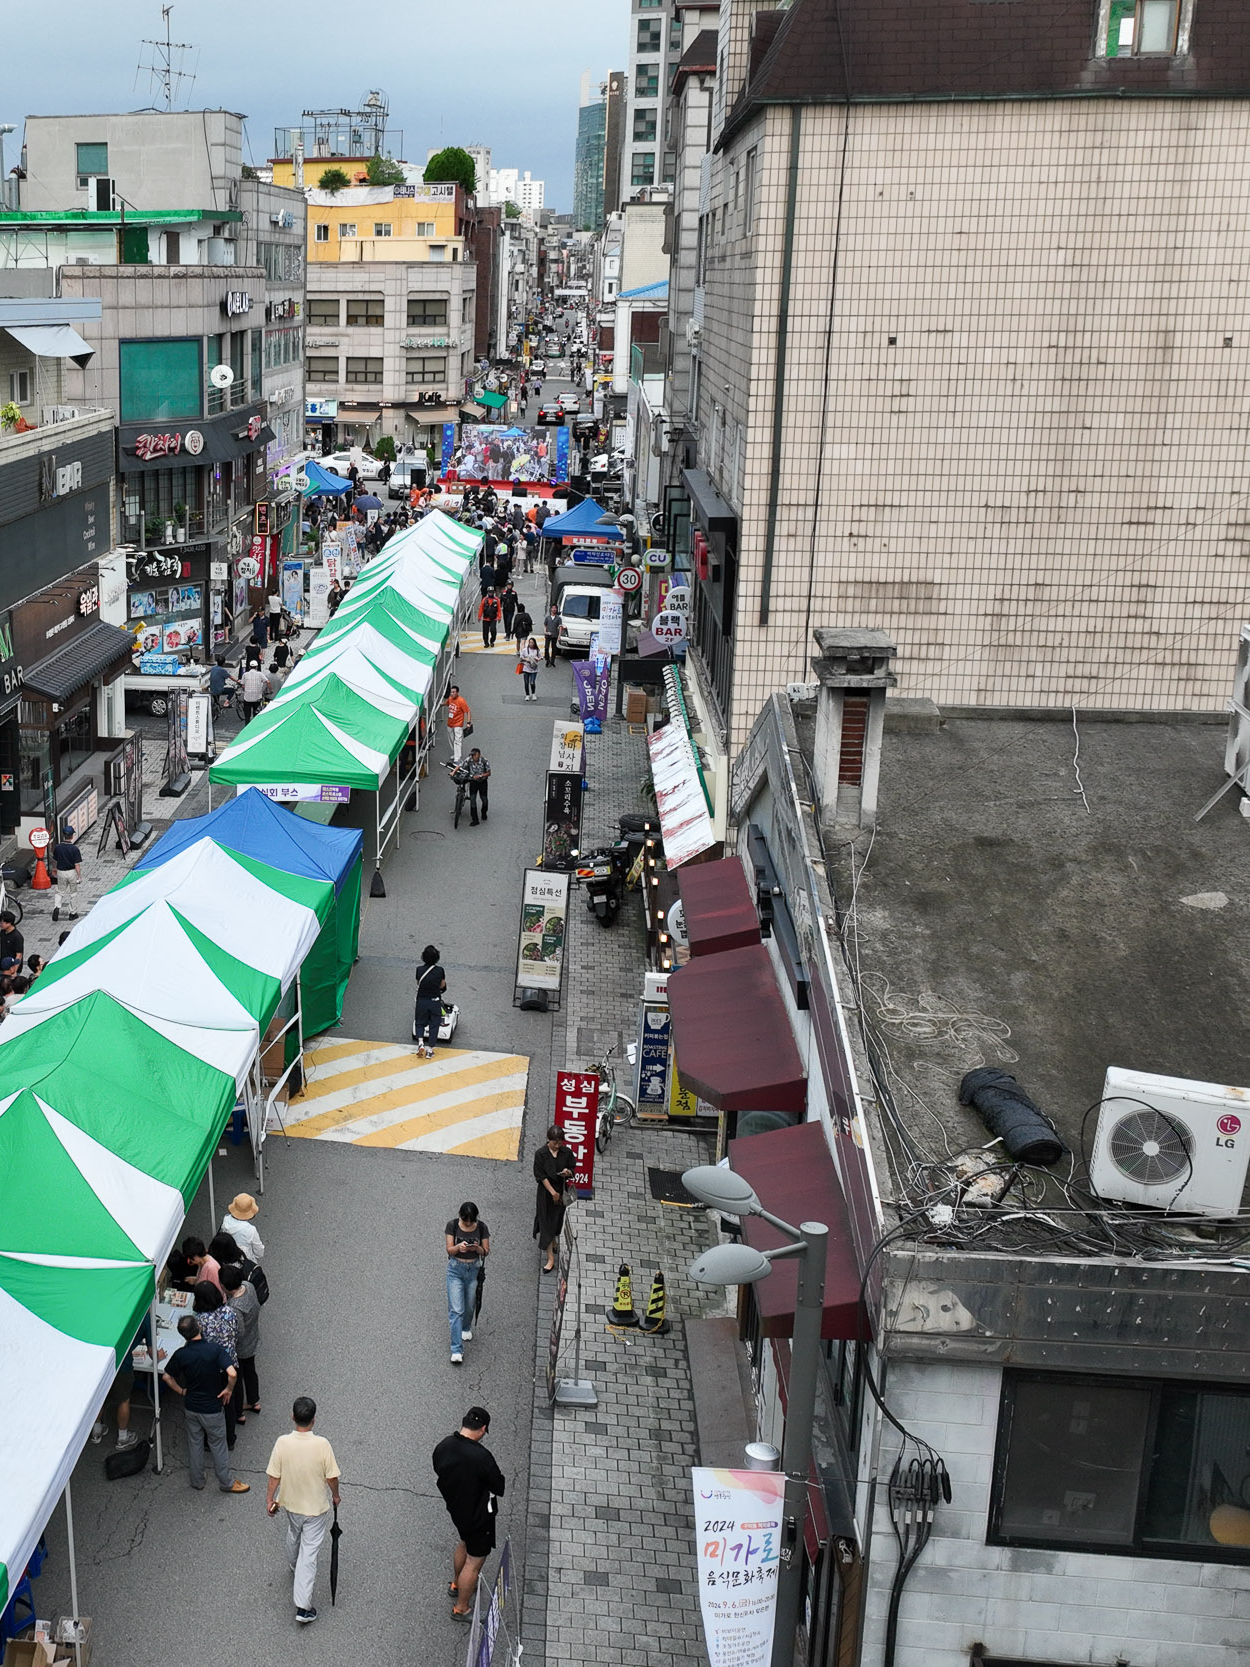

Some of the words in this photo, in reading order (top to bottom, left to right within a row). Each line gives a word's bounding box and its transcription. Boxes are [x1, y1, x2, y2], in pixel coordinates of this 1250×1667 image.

[57, 462, 82, 495] BAR
[649, 554, 667, 562] CU
[622, 574, 637, 585] 30
[669, 603, 688, 611] BAR
[659, 615, 681, 627] 블랙
[655, 627, 683, 637] BAR
[4, 665, 25, 694] BAR
[565, 742, 577, 771] 마사지
[530, 886, 562, 898] 점심특선
[642, 1049, 667, 1058] CAFE
[560, 1078, 595, 1093] 성심
[1215, 1137, 1236, 1149] LG
[703, 1520, 735, 1533] 2024
[703, 1533, 780, 1567] 미가로
[706, 1566, 779, 1590] 음식문화축제
